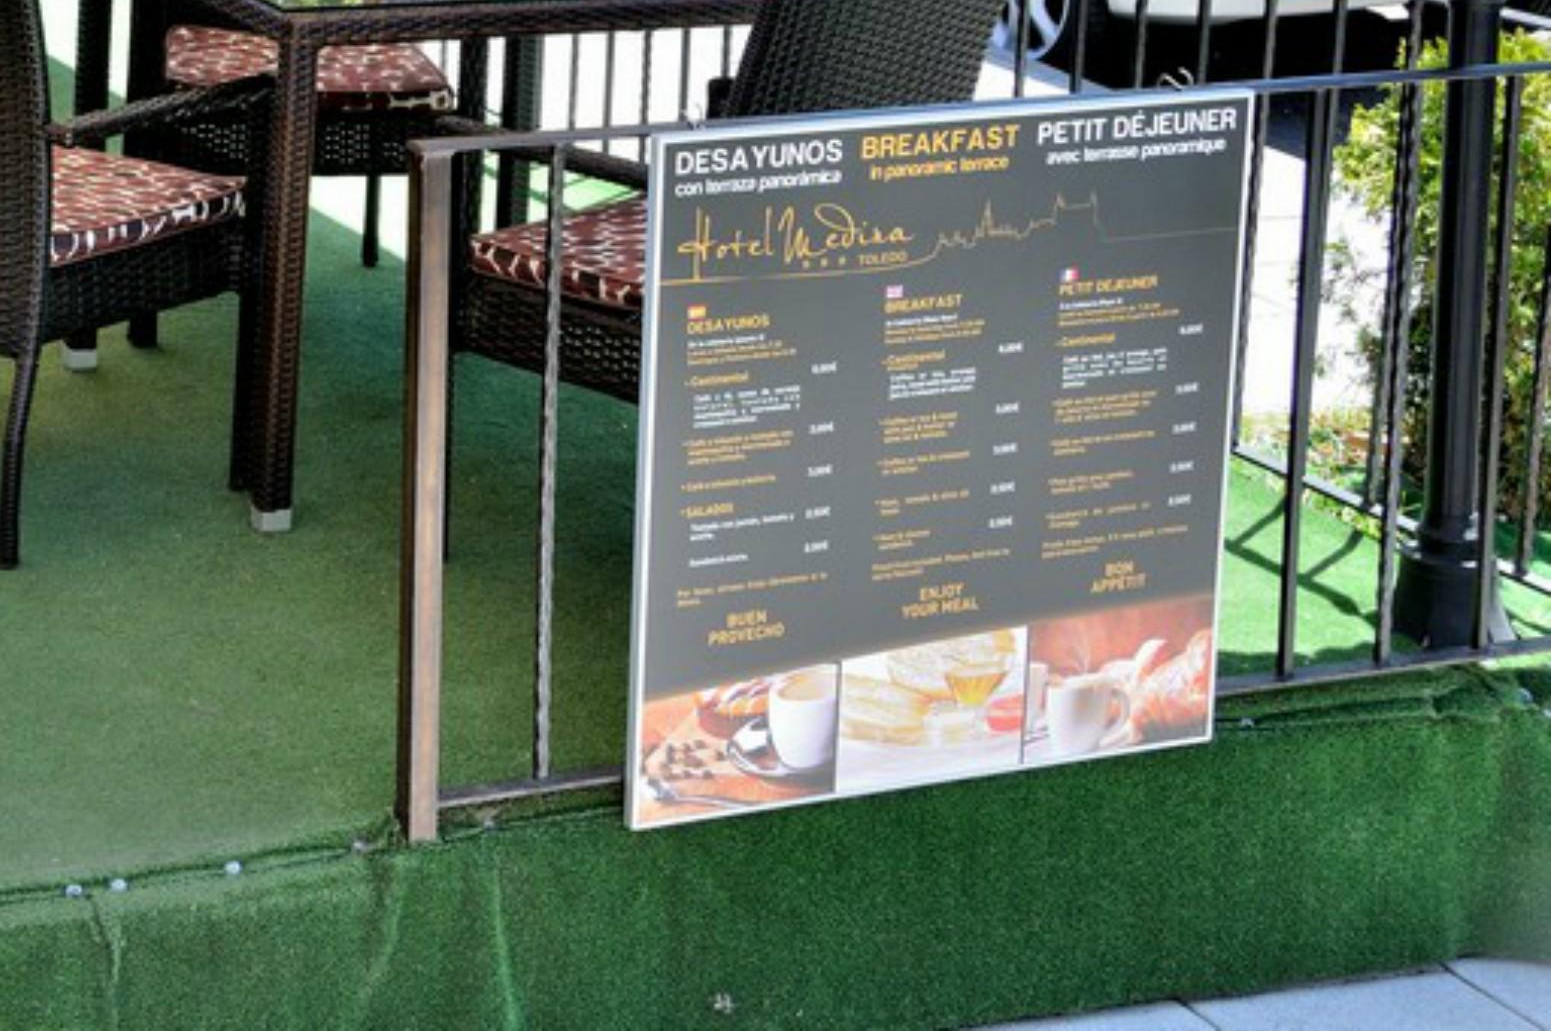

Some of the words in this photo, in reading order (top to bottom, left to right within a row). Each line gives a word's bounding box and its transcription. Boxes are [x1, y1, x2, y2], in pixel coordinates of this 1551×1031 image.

[1037, 118, 1108, 146] PETIT
[1113, 108, 1238, 139] DÉJEUNER
[861, 124, 1020, 160] BREAKFAST
[1046, 148, 1081, 166] avec
[1083, 143, 1139, 163] terrasse
[1140, 137, 1228, 162] panoramique
[674, 138, 844, 176] DESAYUNOS
[870, 165, 883, 180] in
[883, 157, 958, 182] panoramic
[959, 155, 1010, 174] terrace
[674, 180, 703, 198] con
[705, 174, 756, 196] terraza
[757, 168, 843, 193] panorámica
[677, 206, 775, 282] Hotel
[857, 250, 909, 267] TOLEDO
[1059, 281, 1094, 296] PETIT
[884, 293, 963, 314] BREAKFAST
[687, 314, 770, 335] DESAYUNOS
[920, 582, 967, 601] ENJOY
[901, 601, 940, 620] YOUR
[941, 596, 979, 613] MEAL
[707, 622, 785, 647] PROVECHO
